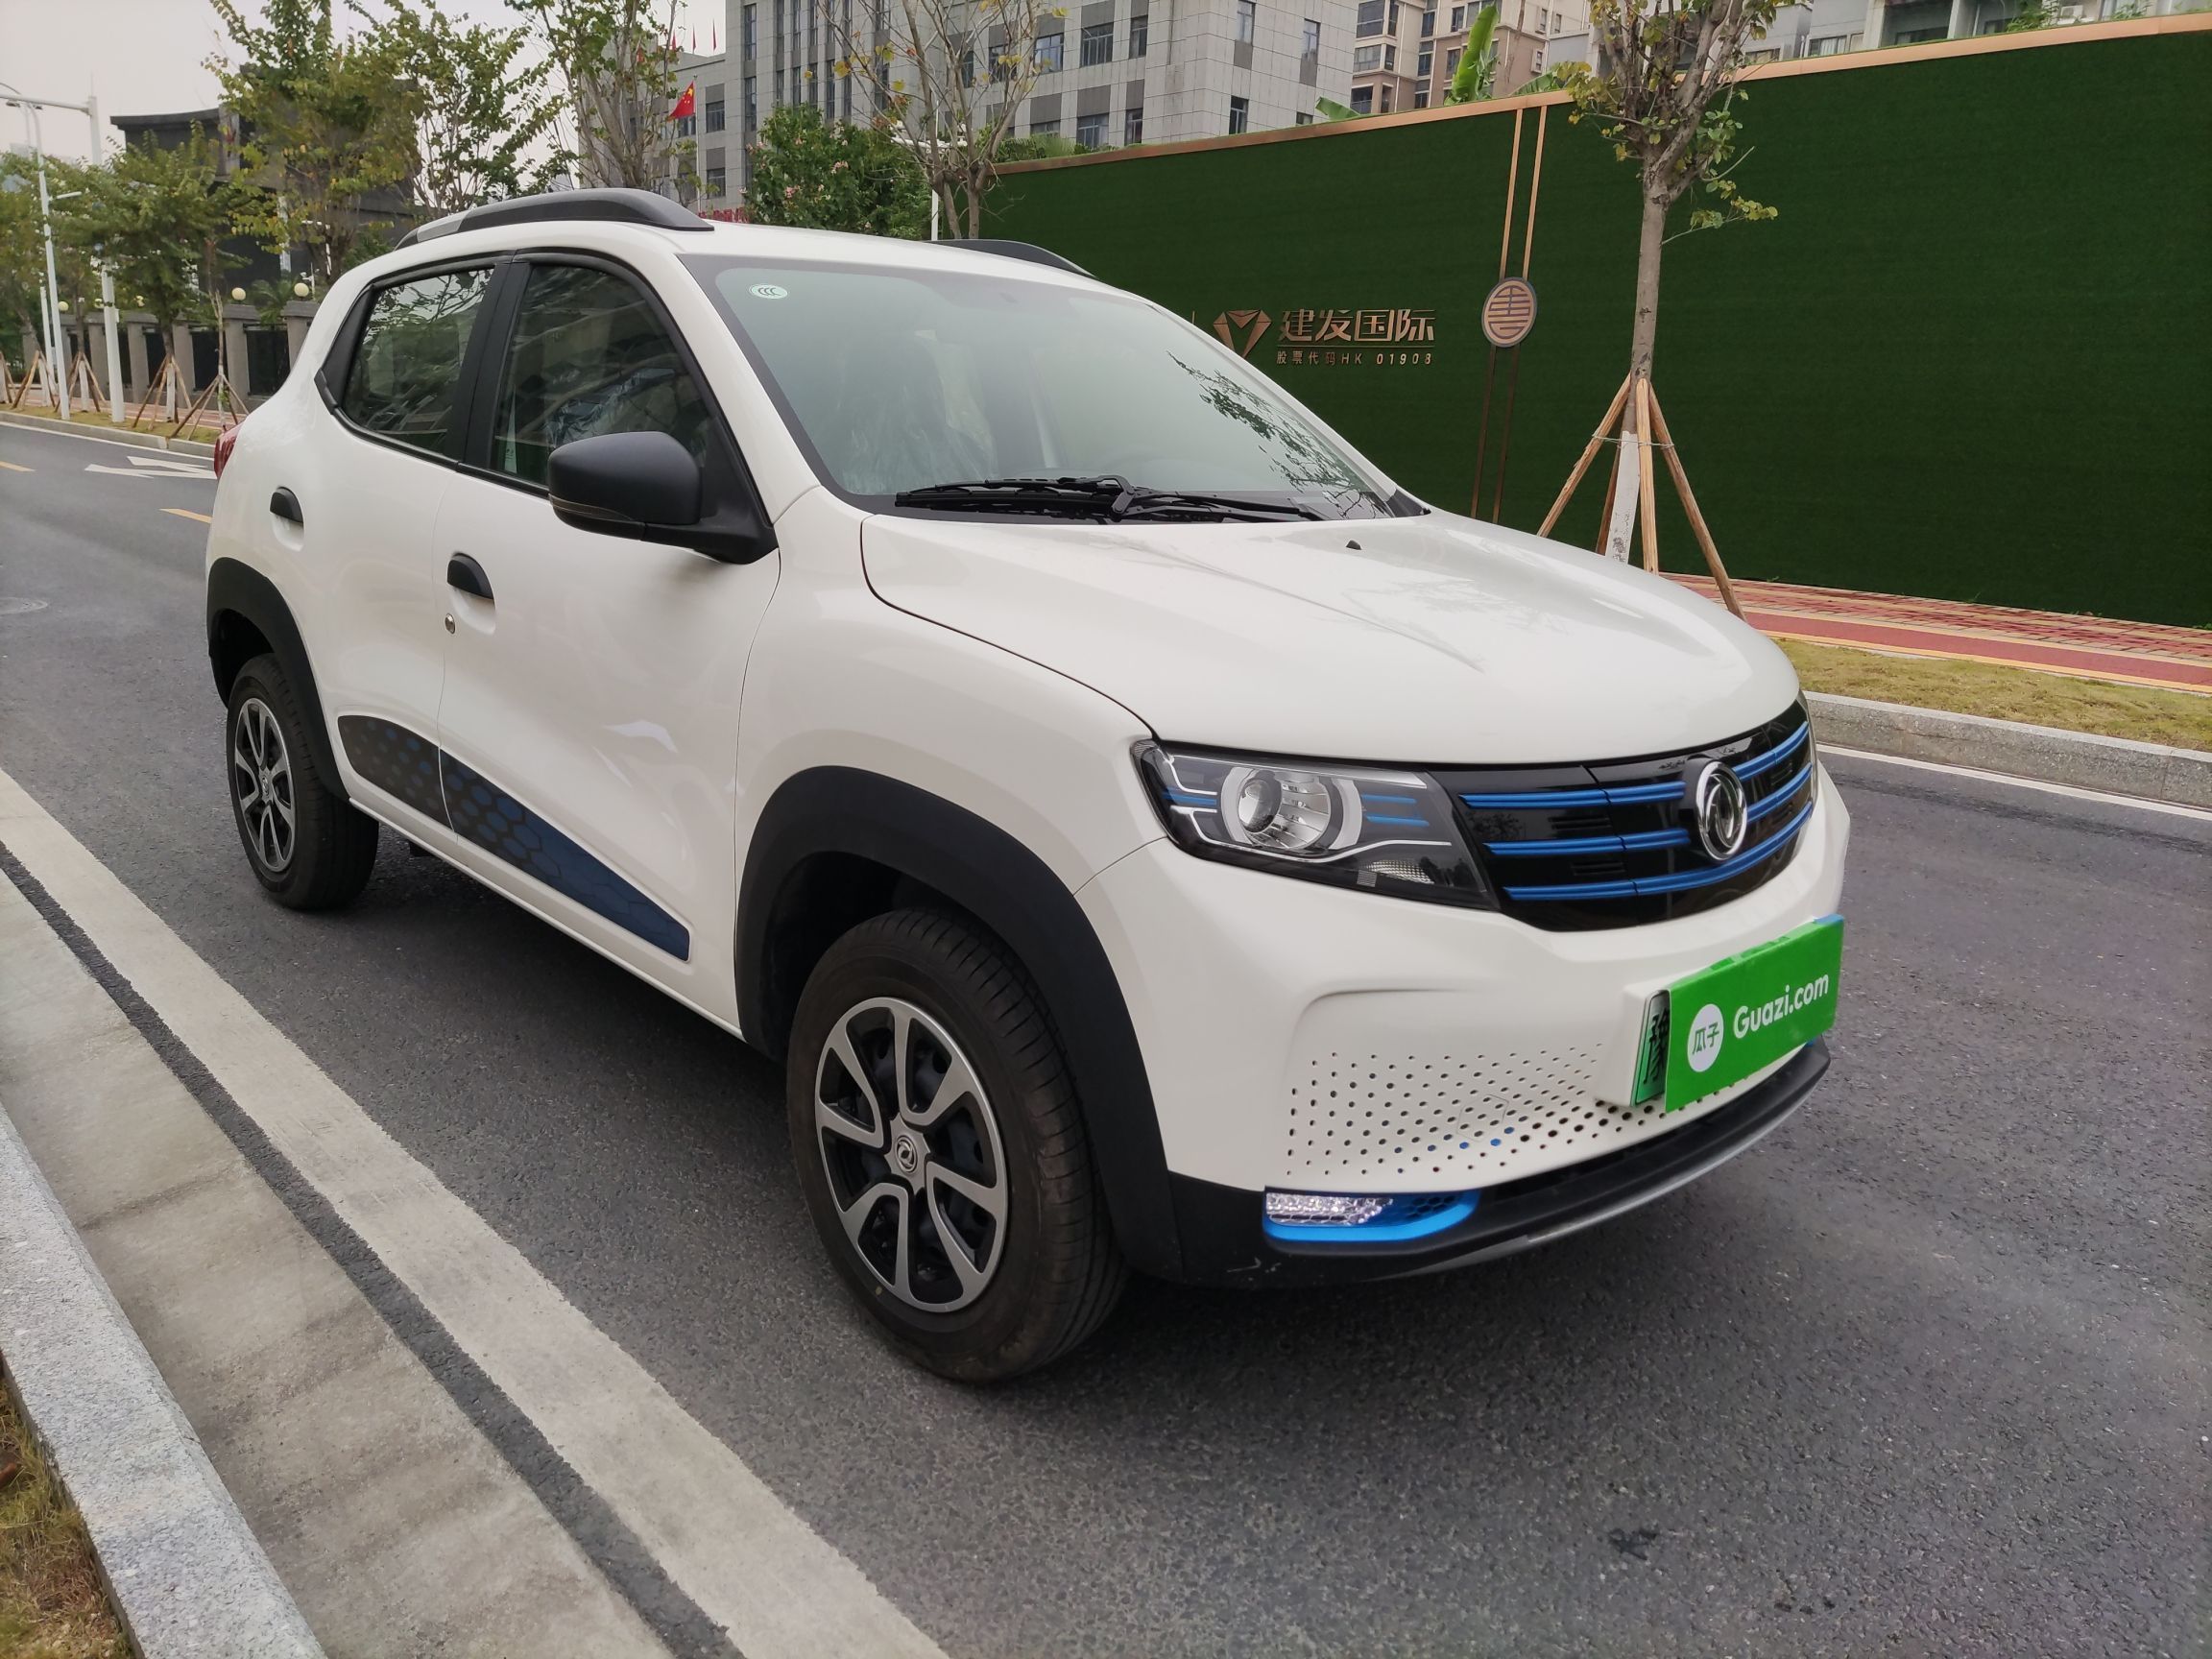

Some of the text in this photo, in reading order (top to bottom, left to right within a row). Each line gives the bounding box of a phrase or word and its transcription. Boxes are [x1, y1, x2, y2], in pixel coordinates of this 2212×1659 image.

[1278, 308, 1436, 342] 建发国际
[1376, 352, 1431, 365] 01908
[1692, 973, 1830, 1055] 瓜子 Guazi.com
